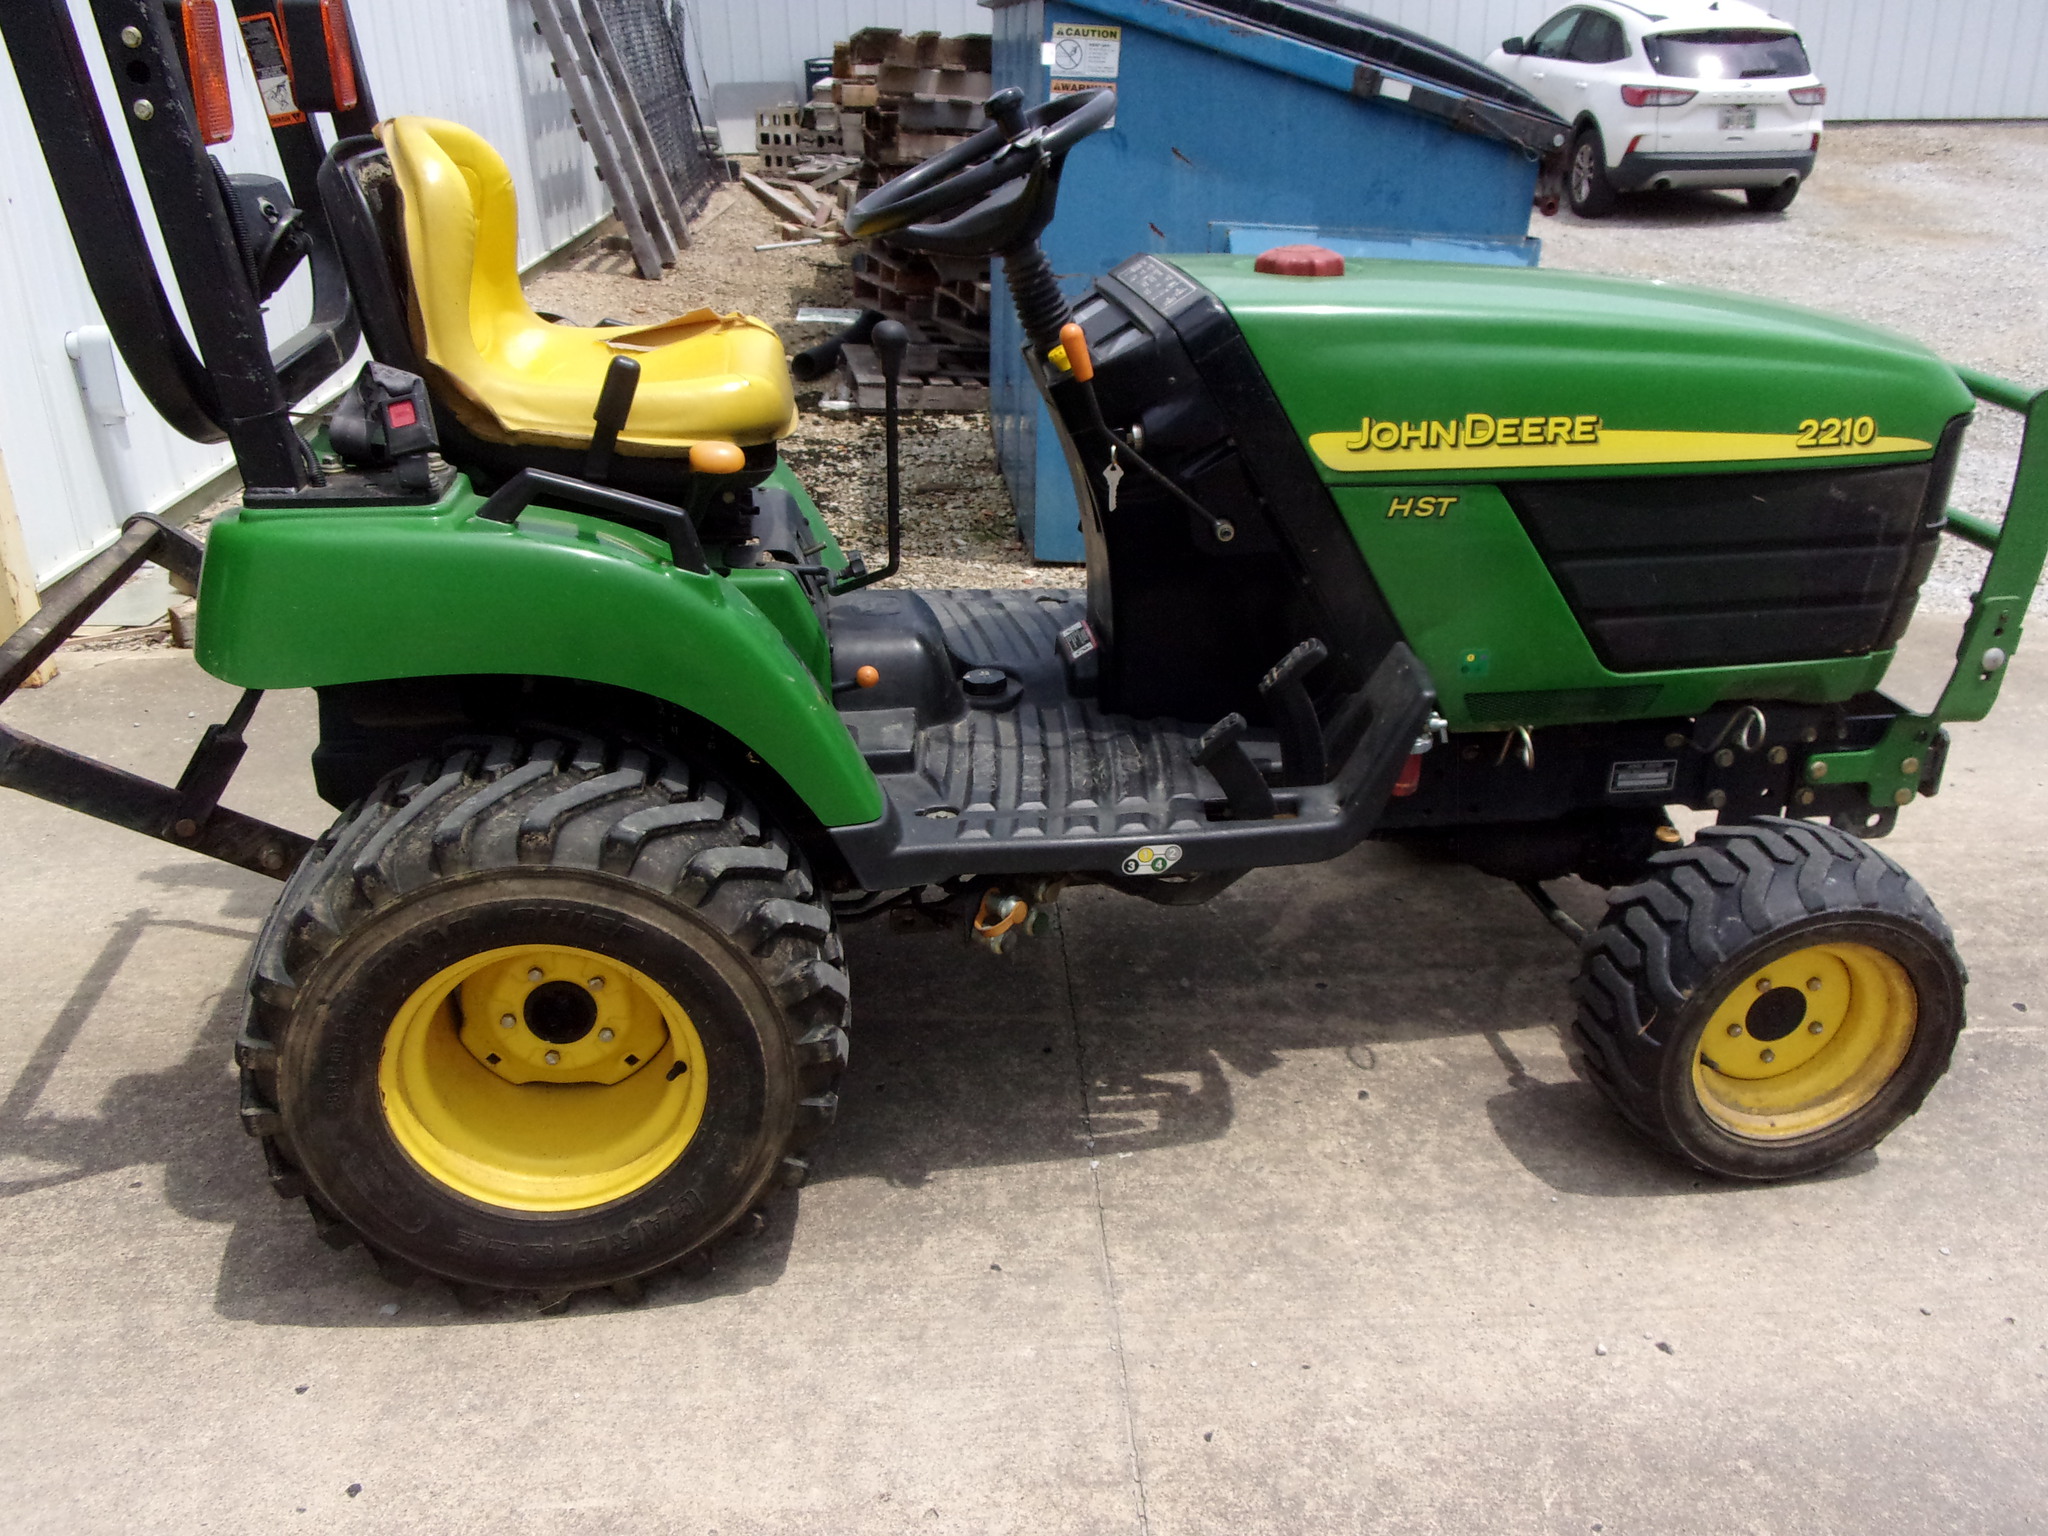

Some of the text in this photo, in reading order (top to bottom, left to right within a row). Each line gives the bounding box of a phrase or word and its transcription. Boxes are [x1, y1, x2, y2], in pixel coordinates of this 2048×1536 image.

[1065, 28, 1118, 39] CAUTION
[1061, 83, 1113, 91] WARN
[1346, 413, 1876, 450] JOHN DEERE 2210
[1386, 496, 1458, 519] HST
[1127, 859, 1163, 872] 3 4
